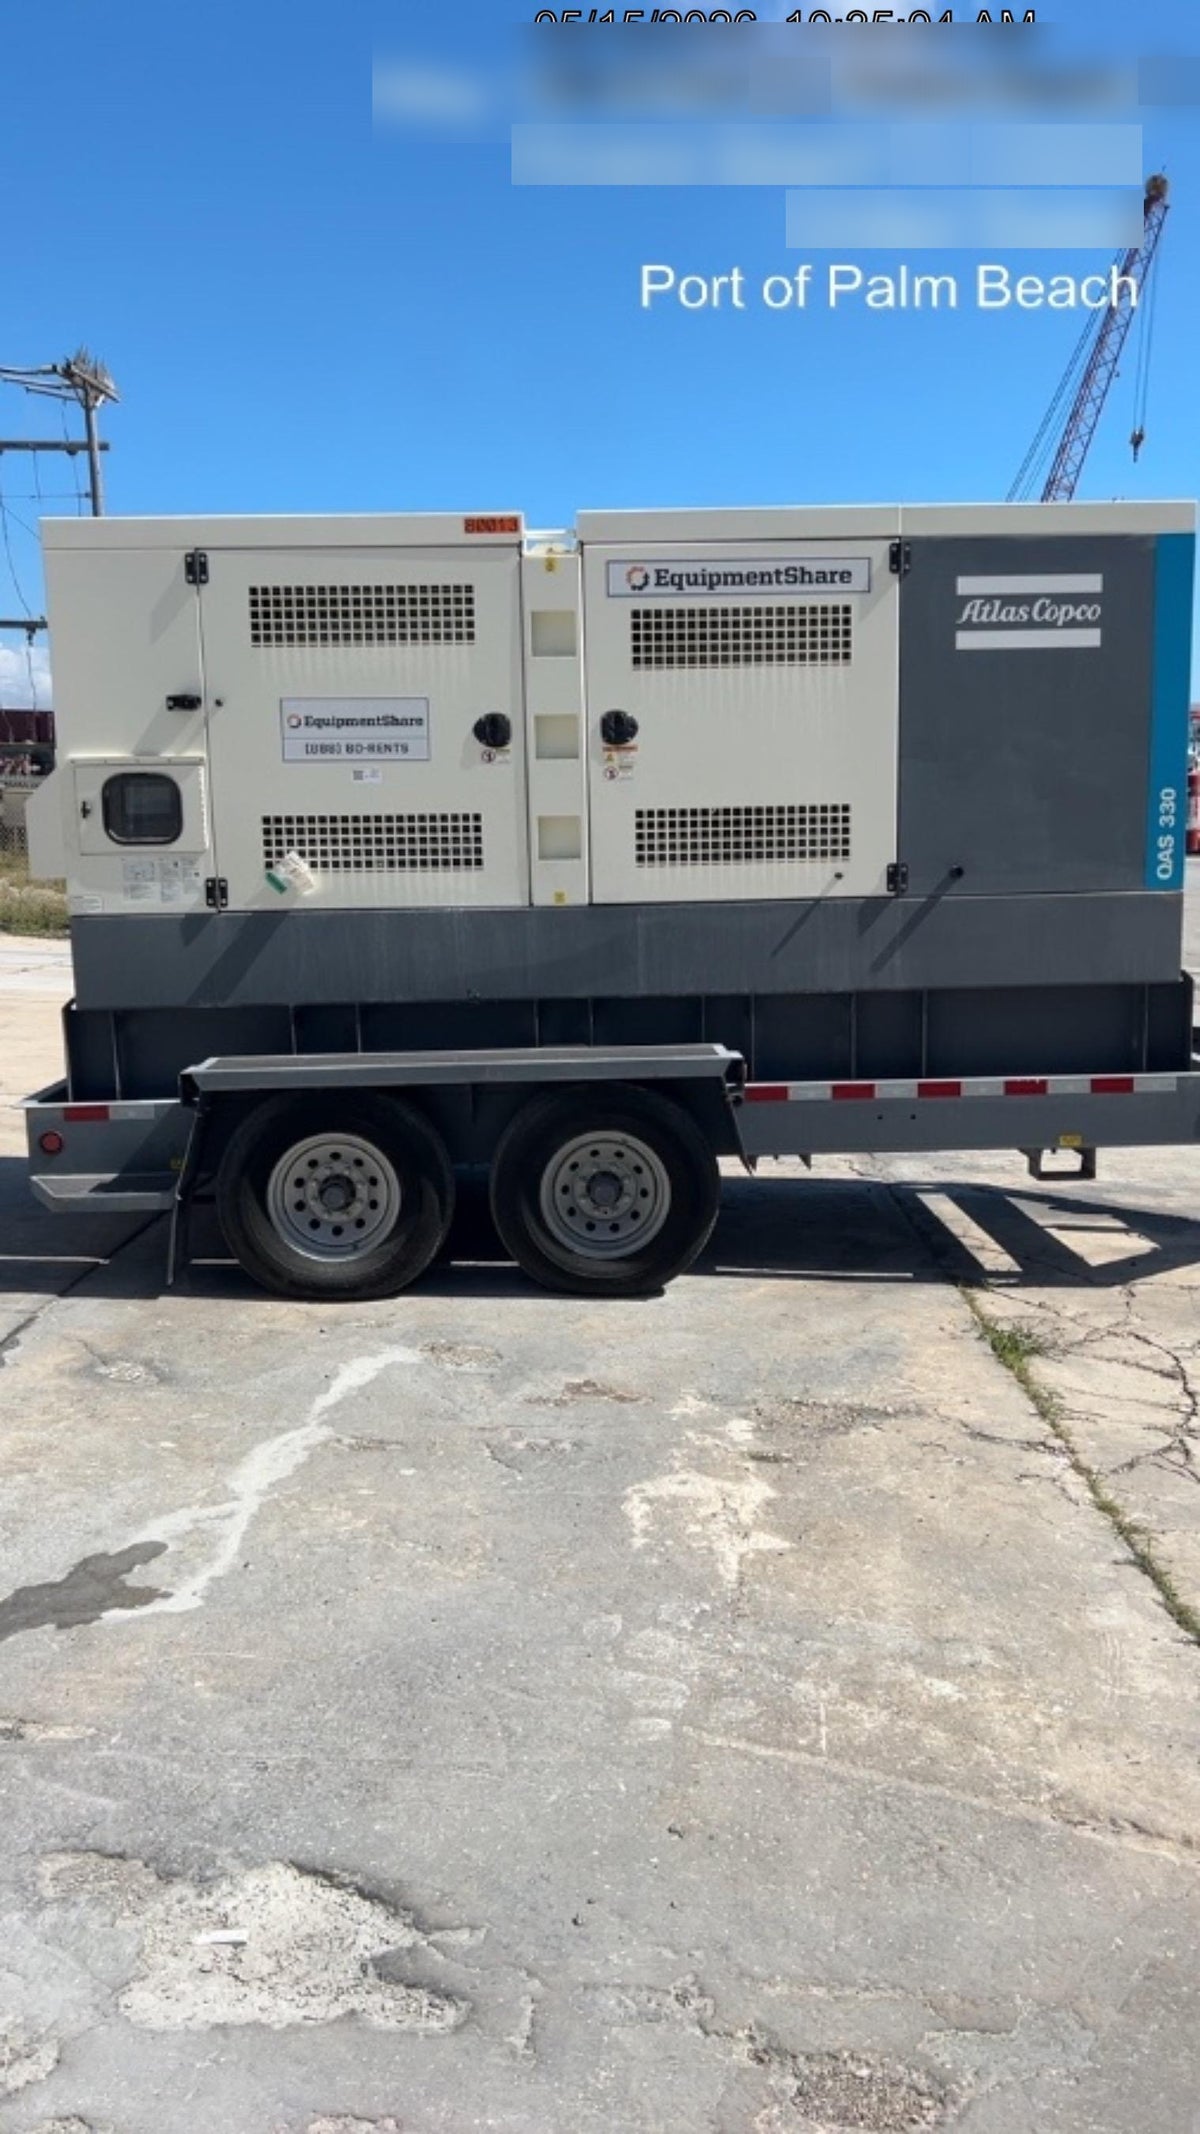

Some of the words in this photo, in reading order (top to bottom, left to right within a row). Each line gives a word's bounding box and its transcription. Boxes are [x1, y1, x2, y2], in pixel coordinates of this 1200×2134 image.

[654, 567, 852, 590] EquipmentShare
[955, 599, 1030, 624] Atlas
[1031, 597, 1101, 627] Copco
[303, 715, 424, 730] EquipmentShare
[1159, 787, 1176, 828] 330
[1156, 834, 1175, 880] QAS
